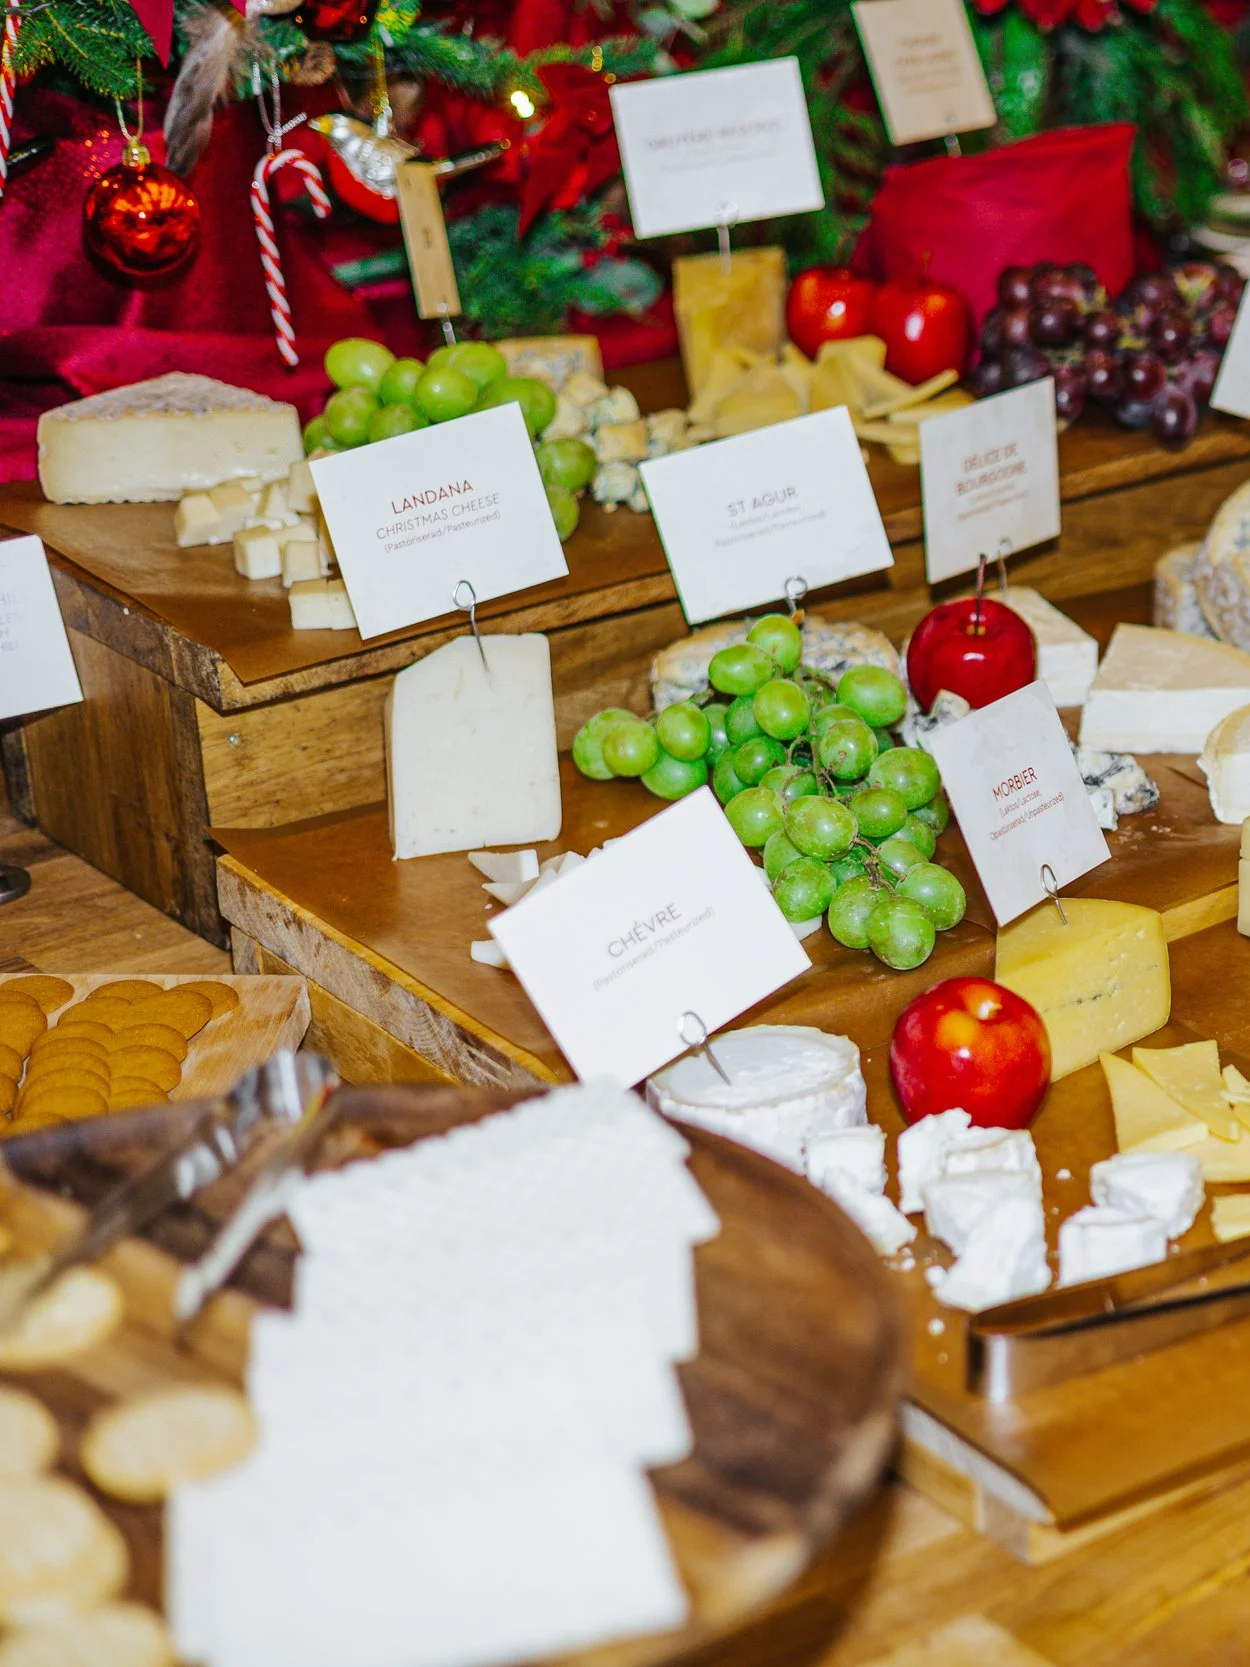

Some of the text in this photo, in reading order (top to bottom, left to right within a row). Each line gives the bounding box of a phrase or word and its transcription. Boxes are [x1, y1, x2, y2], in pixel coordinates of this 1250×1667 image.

[391, 479, 474, 515] LANDANA
[728, 486, 799, 517] ST AGUR
[376, 493, 501, 540] CHRISTMAS CHEESE
[992, 767, 1038, 800] MORBIER
[608, 903, 683, 958] CHÉVRE
